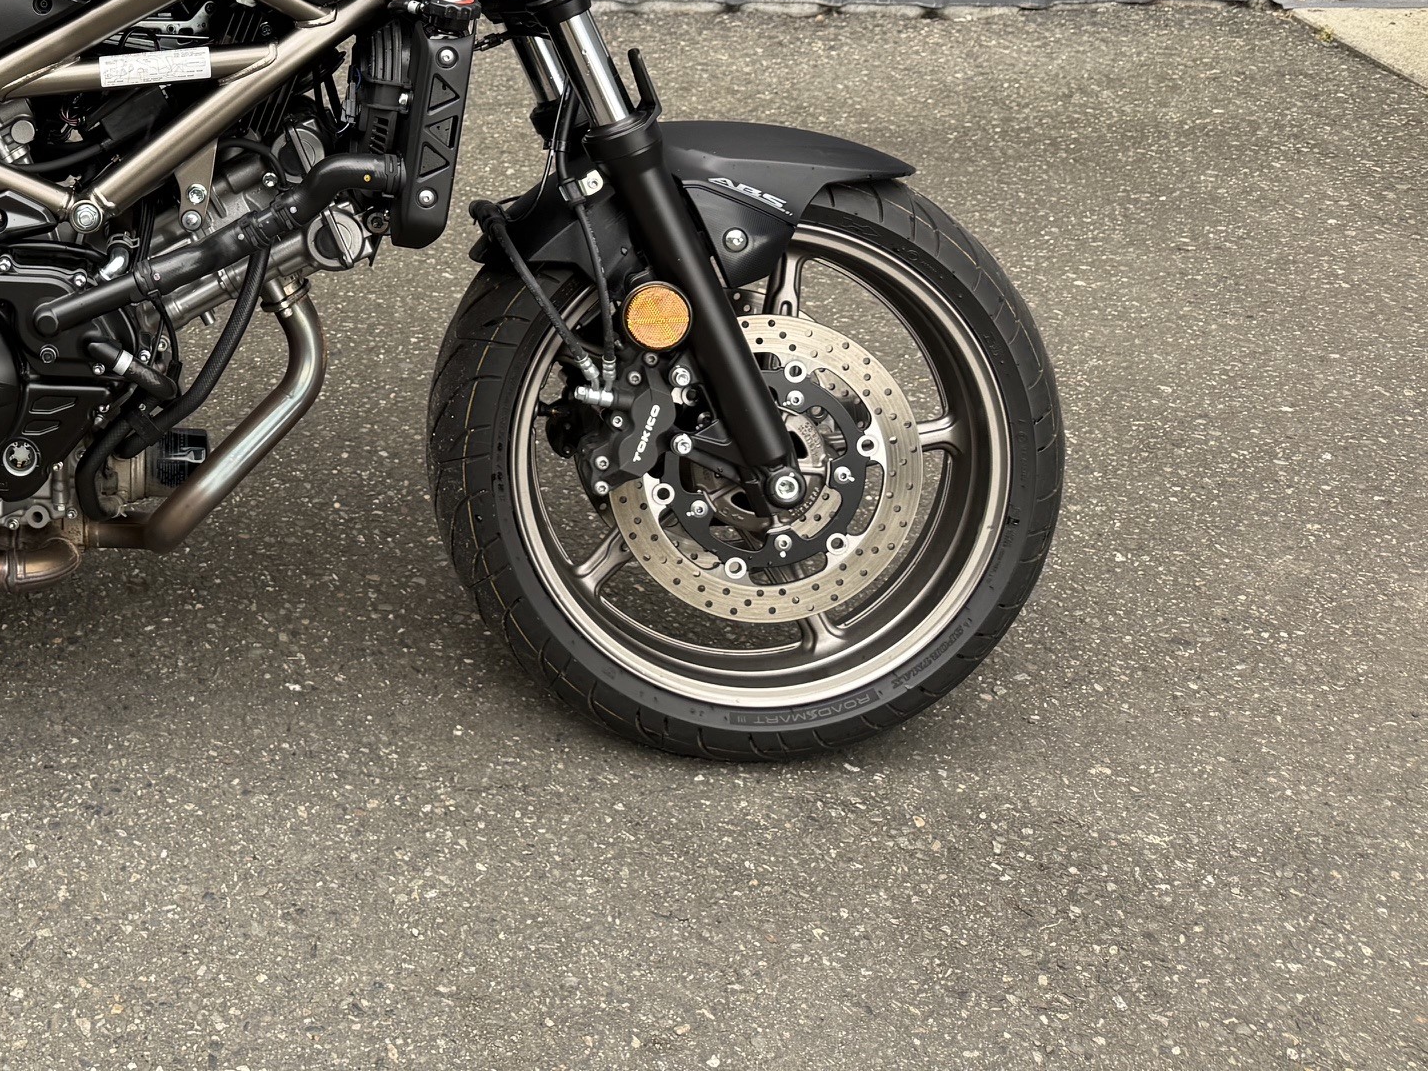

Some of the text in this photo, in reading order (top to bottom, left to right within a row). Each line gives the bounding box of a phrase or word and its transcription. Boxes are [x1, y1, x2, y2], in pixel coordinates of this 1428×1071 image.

[708, 177, 788, 210] ABS
[633, 404, 661, 463] TOKICO
[891, 625, 964, 689] SPORTMAX
[753, 690, 872, 725] ROADSMART
